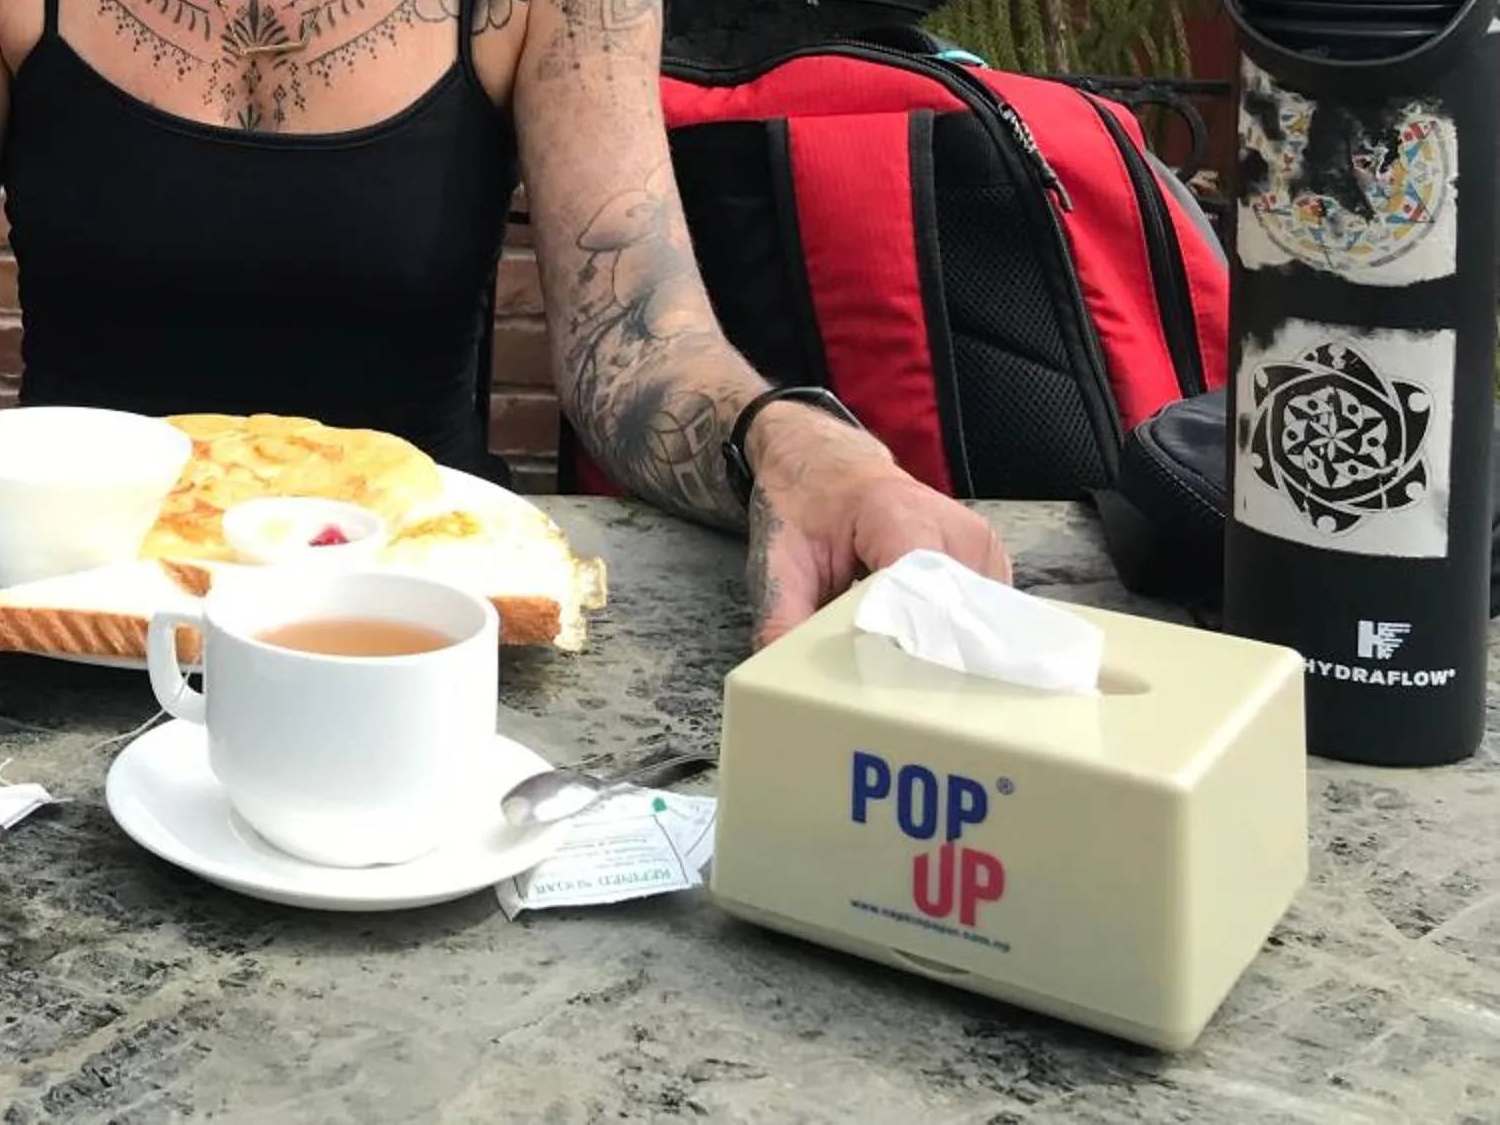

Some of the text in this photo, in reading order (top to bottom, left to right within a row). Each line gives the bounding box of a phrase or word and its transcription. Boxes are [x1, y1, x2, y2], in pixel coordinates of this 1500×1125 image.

[1301, 657, 1450, 687] HYDRAFLOW
[852, 752, 988, 842] POP
[912, 842, 1006, 928] UP
